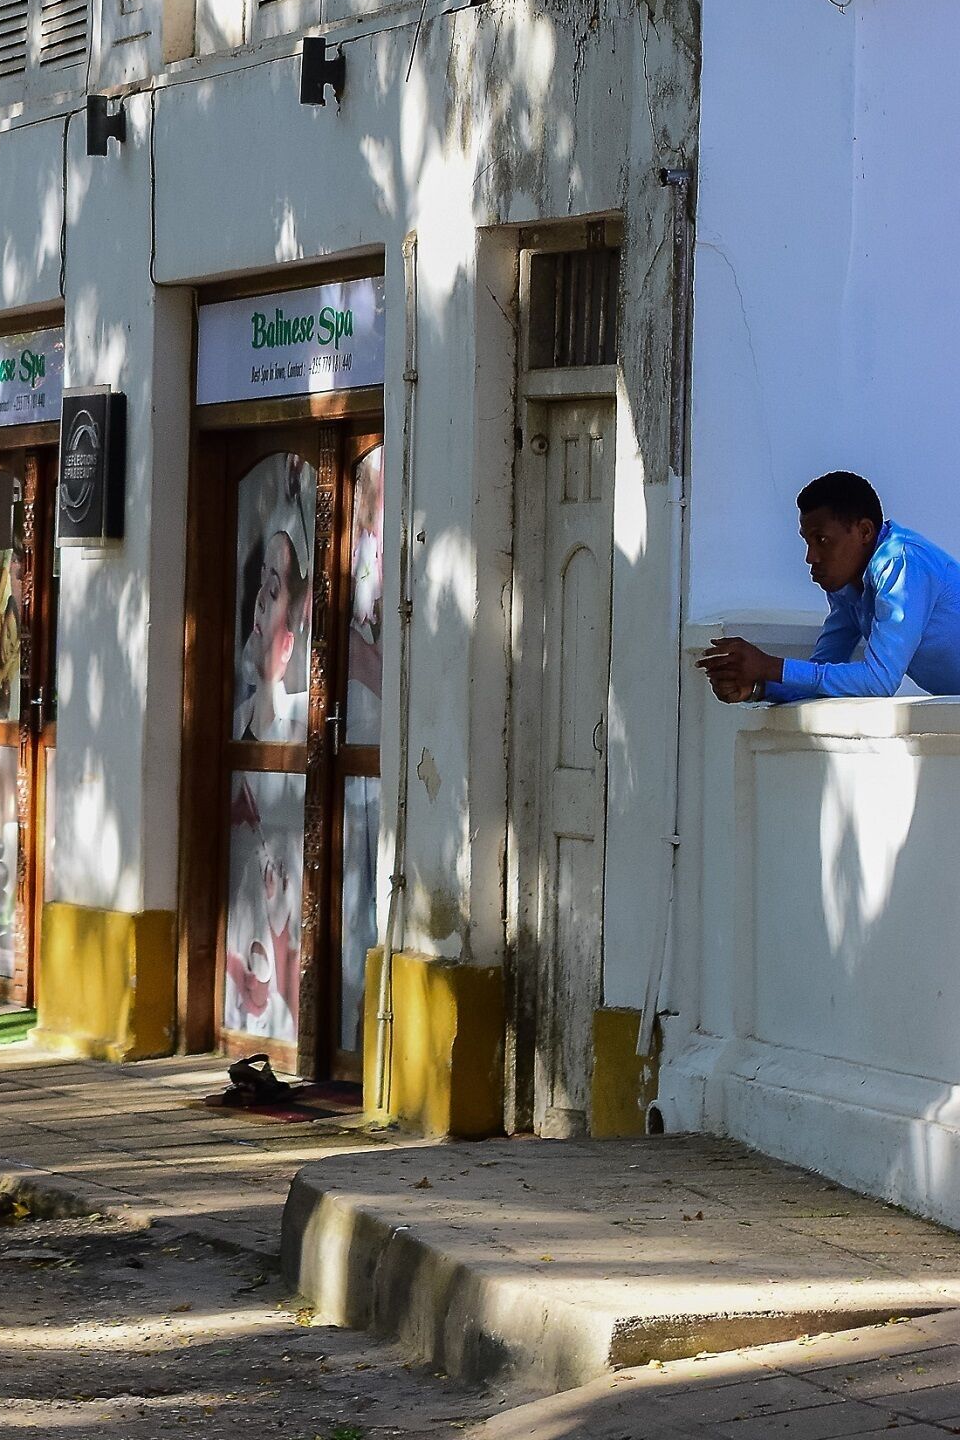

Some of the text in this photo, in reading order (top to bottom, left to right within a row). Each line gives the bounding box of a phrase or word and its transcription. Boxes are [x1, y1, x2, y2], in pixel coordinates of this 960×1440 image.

[251, 306, 354, 350] Balinese Spa
[18, 349, 46, 389] Spa
